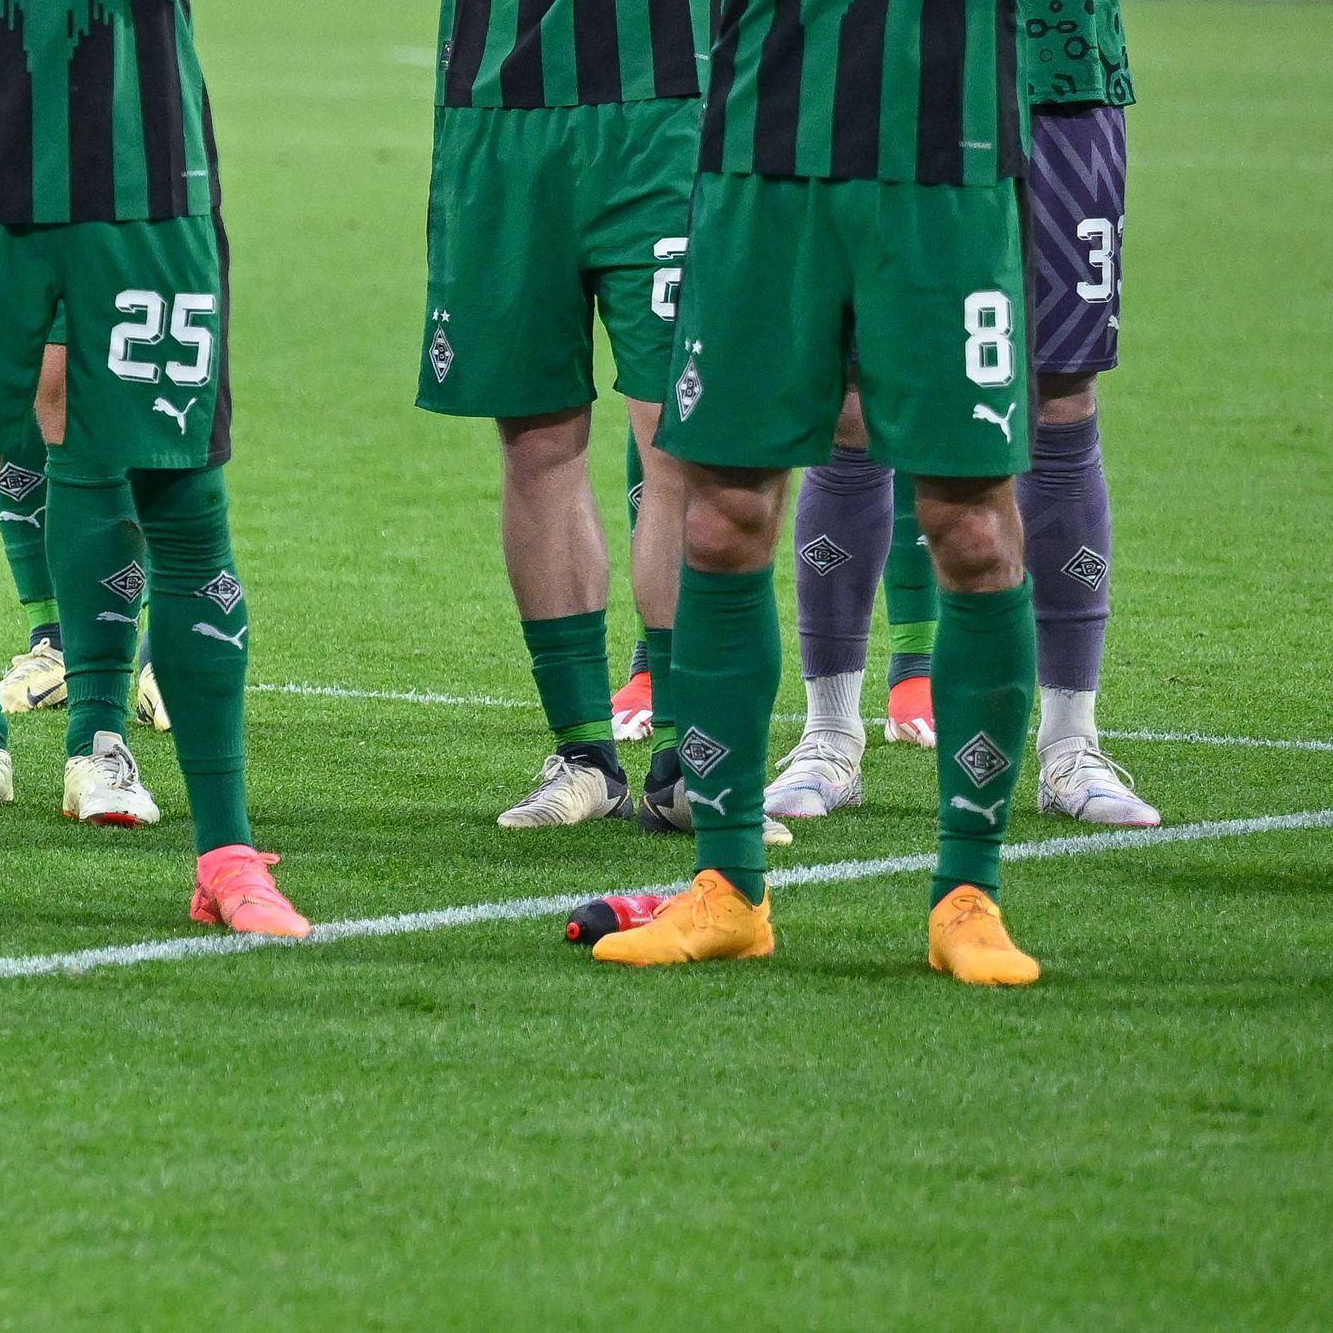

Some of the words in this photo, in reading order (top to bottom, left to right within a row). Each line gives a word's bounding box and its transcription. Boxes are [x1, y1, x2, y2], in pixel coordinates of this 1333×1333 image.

[1076, 217, 1123, 304] 3
[107, 289, 217, 387] 25
[963, 290, 1014, 388] 8
